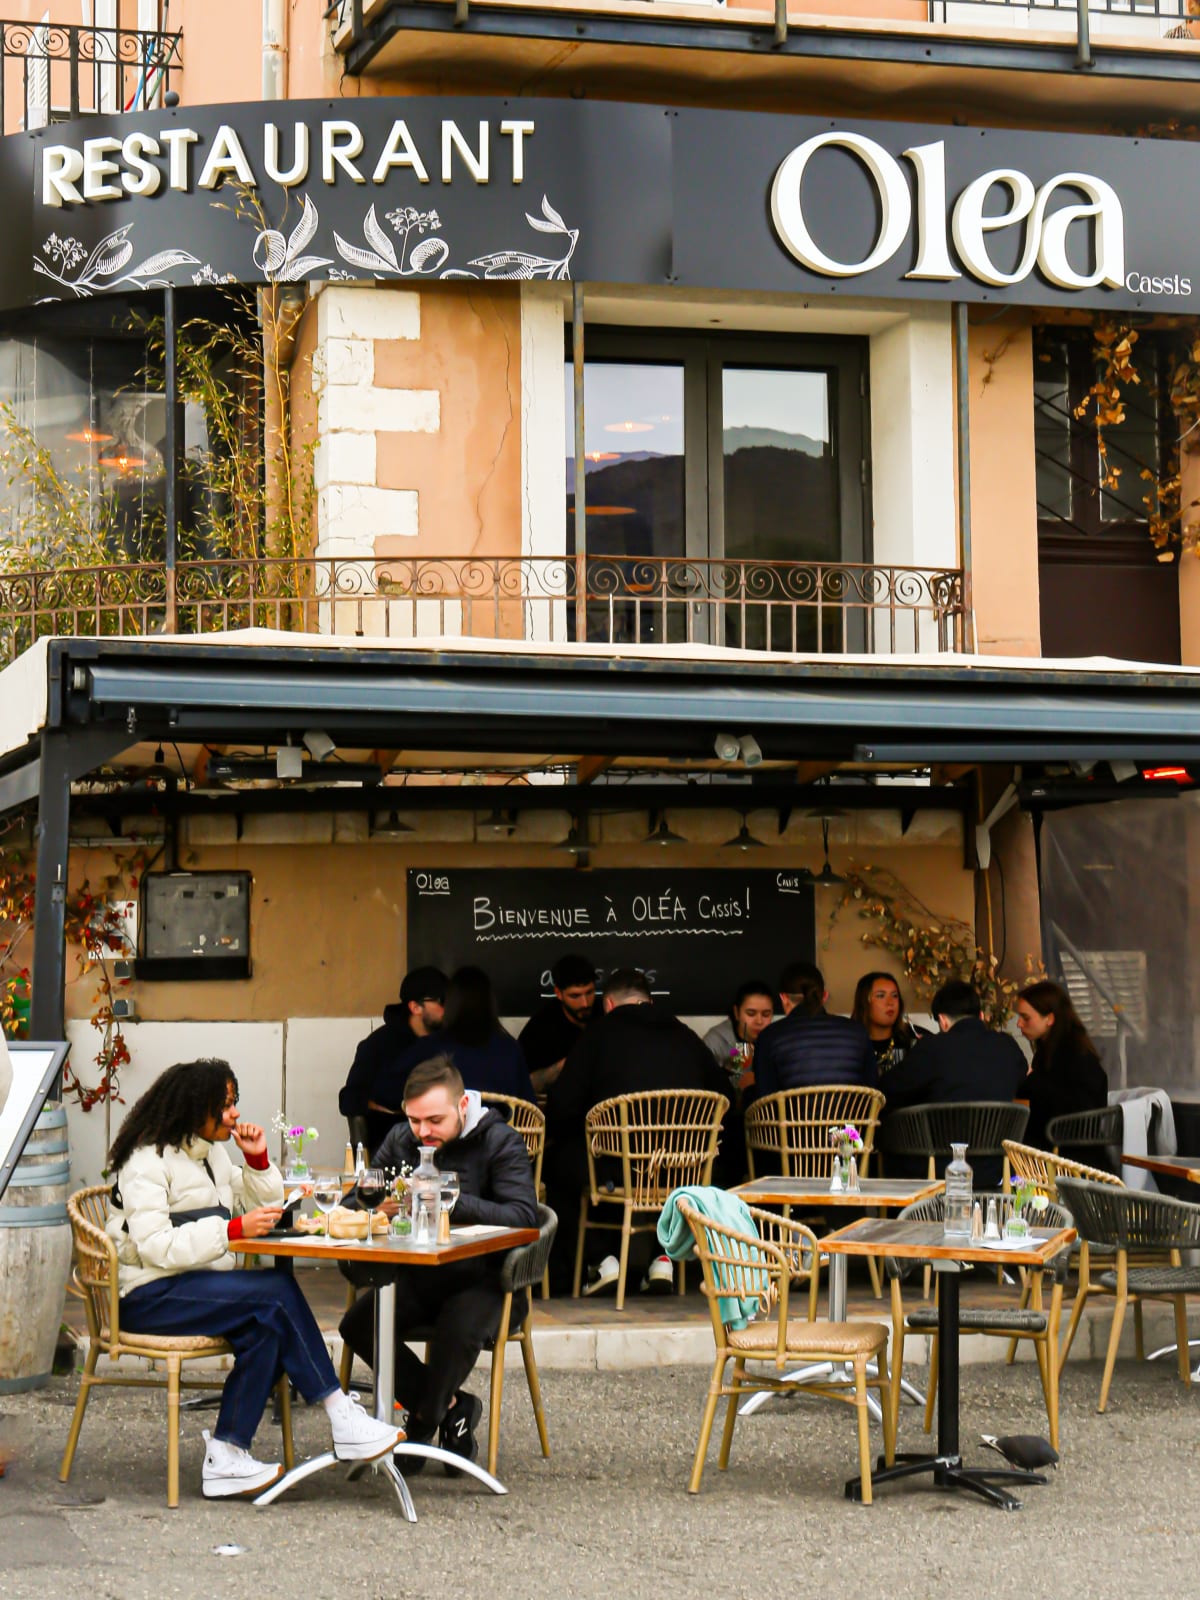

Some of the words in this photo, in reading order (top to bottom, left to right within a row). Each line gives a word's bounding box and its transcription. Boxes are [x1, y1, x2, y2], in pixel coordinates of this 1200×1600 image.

[42, 119, 535, 207] RESTAURANT
[770, 131, 1125, 290] Olea
[1125, 271, 1192, 296] Cassis
[416, 873, 450, 890] Olea
[632, 888, 686, 921] OLÉA
